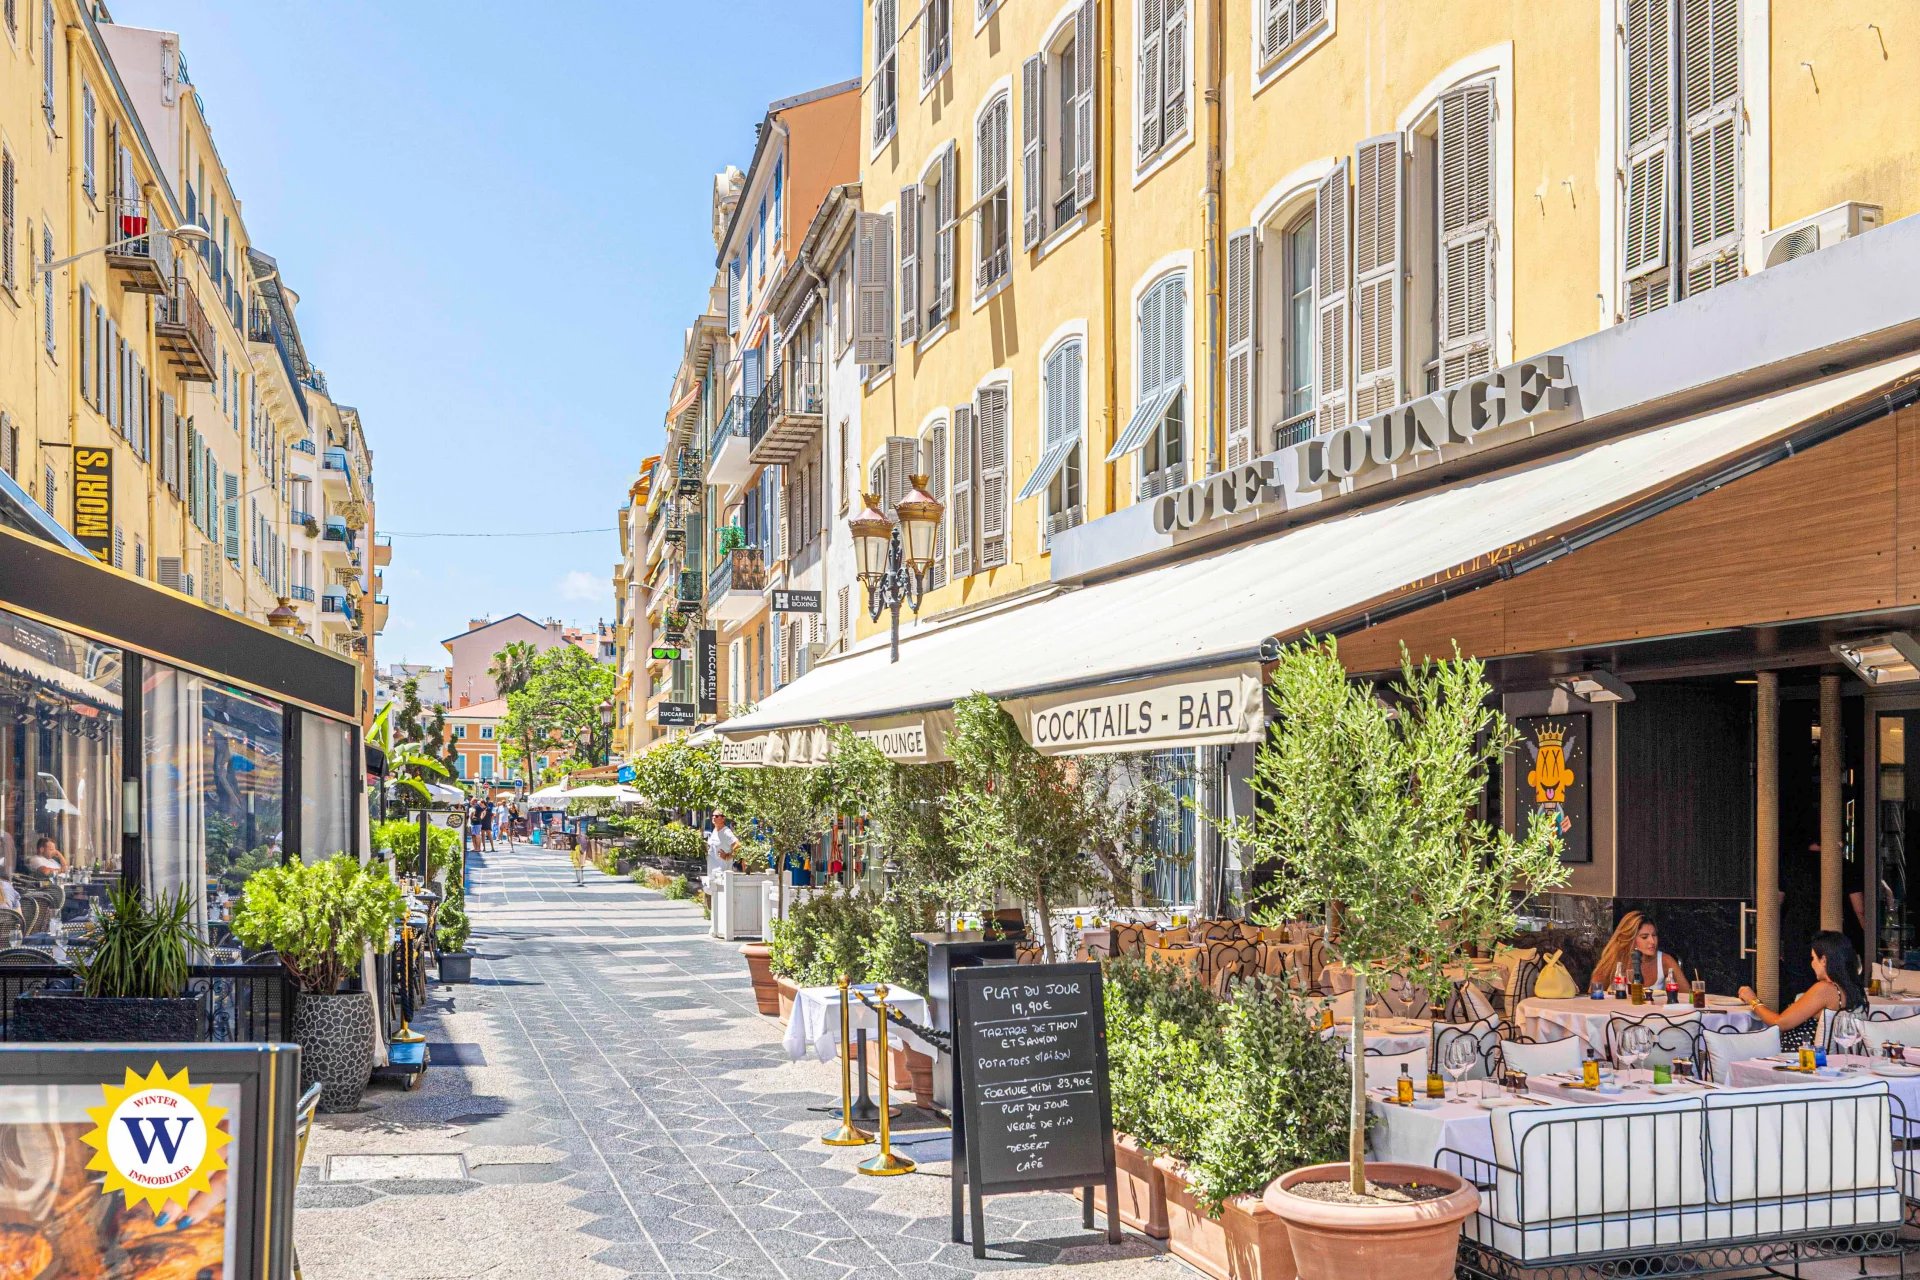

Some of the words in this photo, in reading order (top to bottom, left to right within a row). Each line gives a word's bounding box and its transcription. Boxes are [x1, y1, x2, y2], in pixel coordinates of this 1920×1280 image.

[1153, 459, 1277, 535] COTE
[1294, 355, 1567, 493] LOUNGE
[76, 450, 109, 538] MORI'S
[708, 644, 717, 701] ZUCCARELLI
[1036, 700, 1152, 743] COCKTAILS
[1178, 689, 1234, 731] BAR
[982, 986, 1019, 1001] PLAT
[1023, 985, 1040, 997] DU
[1045, 982, 1081, 995] JOUR
[1011, 1000, 1053, 1016] 19,90€
[978, 1026, 1028, 1038] TARTARE
[1031, 1023, 1046, 1033] DE
[1047, 1019, 1078, 1032] THON
[978, 1056, 1030, 1070] POTATOES
[1056, 1077, 1093, 1090] 23,90€
[1001, 1103, 1025, 1114] PLAT
[1027, 1102, 1041, 1112] DU
[1043, 1099, 1070, 1110] JOUR
[1006, 1121, 1037, 1133] VERRE
[1040, 1119, 1053, 1129] DE
[1006, 1141, 1050, 1153] DESSERT
[1016, 1157, 1044, 1172] CAFÉ
